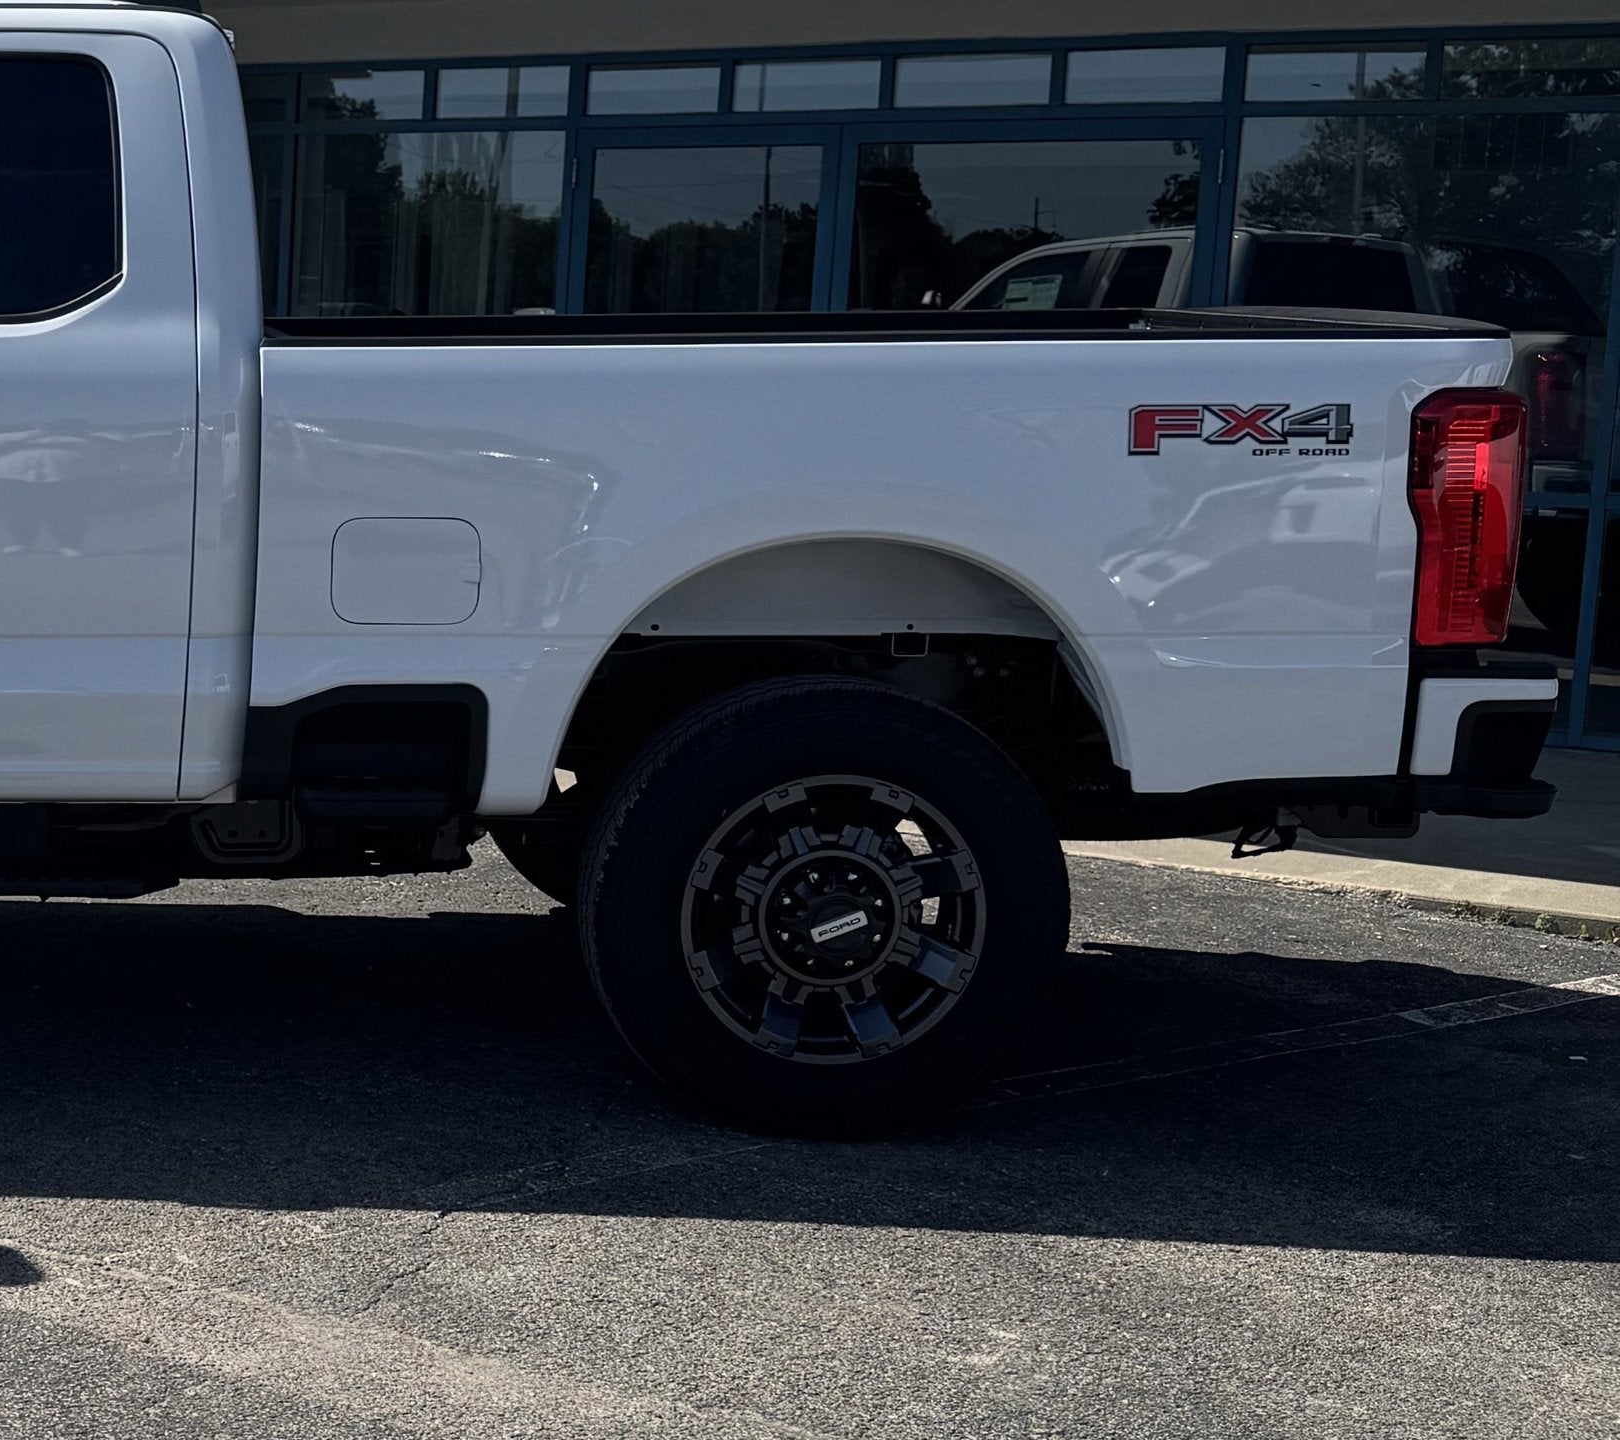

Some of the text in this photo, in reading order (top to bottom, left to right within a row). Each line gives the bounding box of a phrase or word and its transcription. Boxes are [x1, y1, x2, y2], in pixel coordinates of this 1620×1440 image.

[1127, 403, 1354, 456] FX4
[1251, 448, 1350, 457] OFF ROAD
[818, 917, 861, 937] FORD
